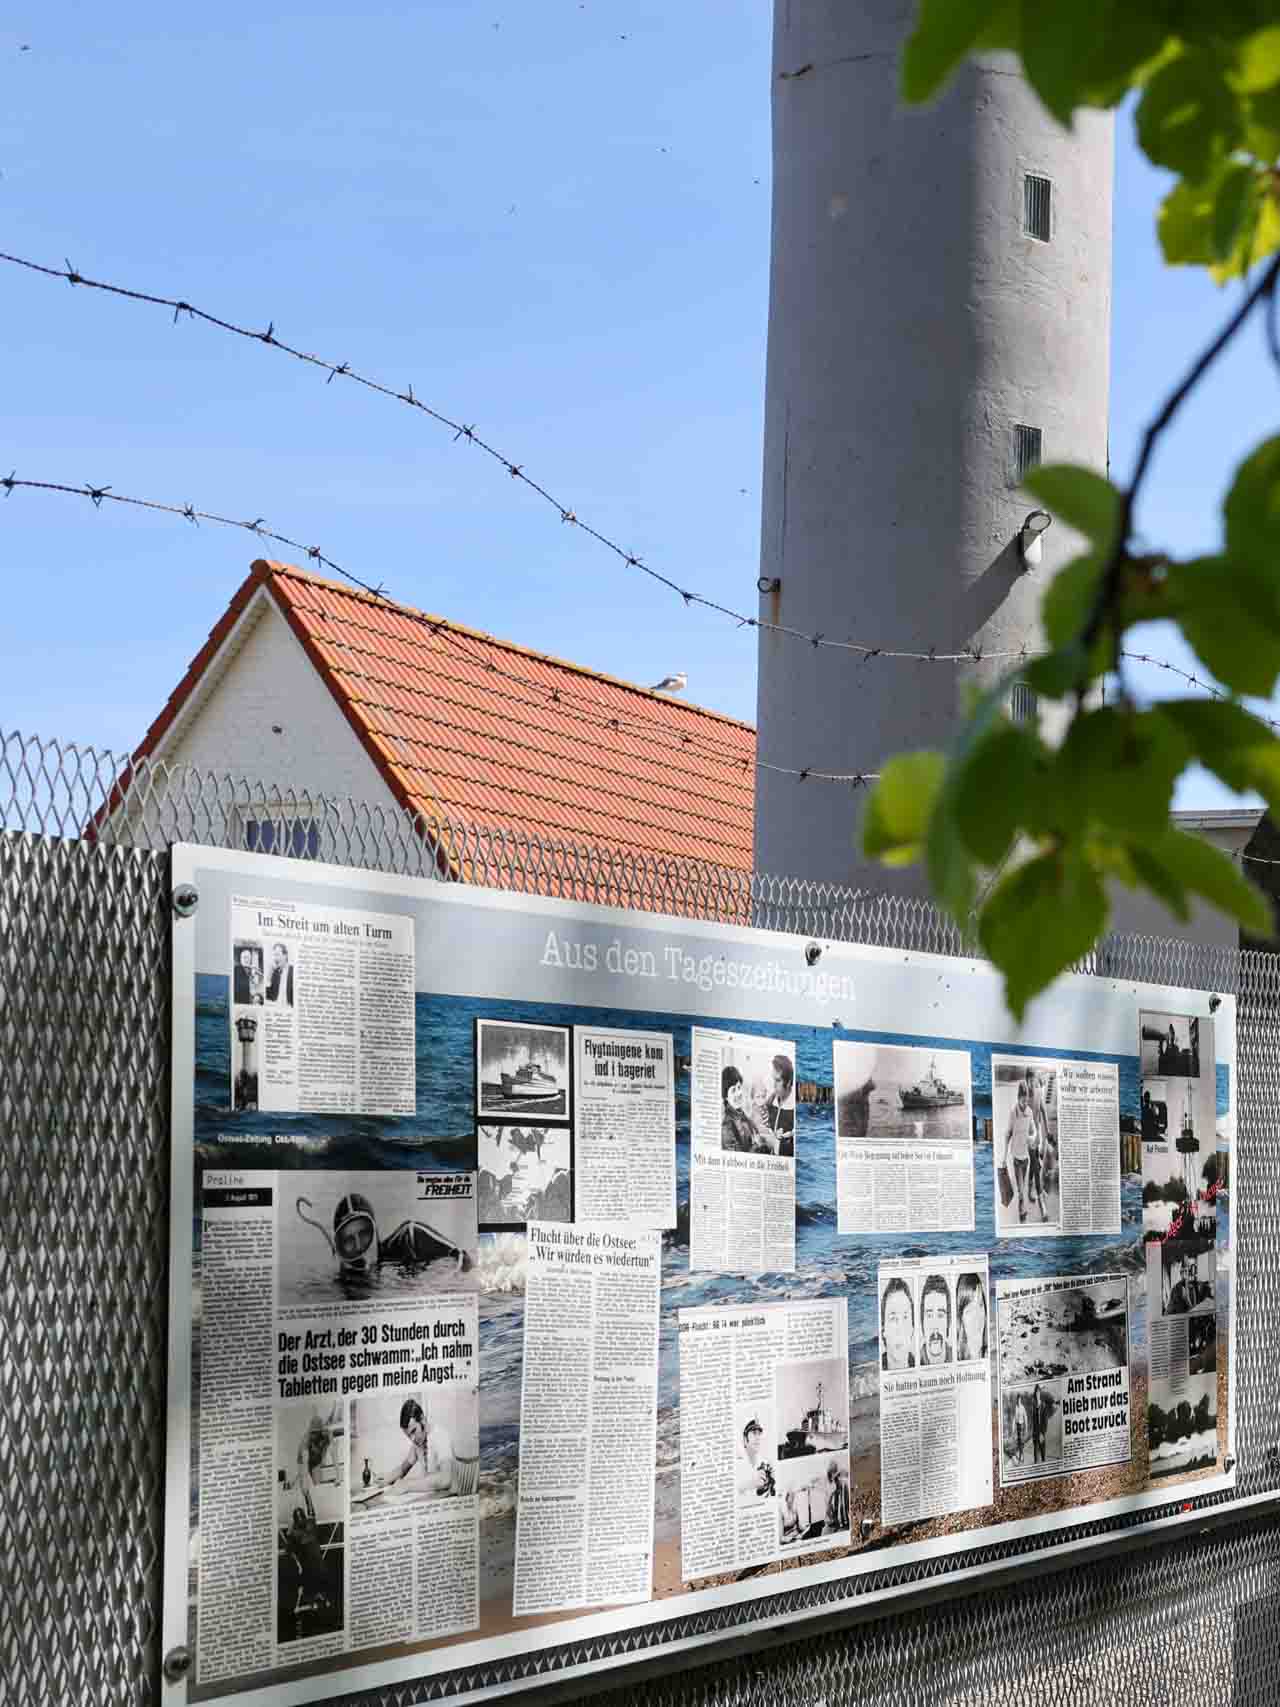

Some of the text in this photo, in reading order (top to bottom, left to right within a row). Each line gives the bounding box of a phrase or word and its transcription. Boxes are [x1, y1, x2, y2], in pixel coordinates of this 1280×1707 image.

[257, 912, 273, 927] Im
[278, 914, 308, 931] Streit
[313, 921, 329, 933] um
[333, 922, 360, 937] alten
[364, 923, 392, 940] Turm
[539, 930, 856, 1003] Aus den Tageszeitungen
[645, 1044, 664, 1060] kom
[425, 1183, 472, 1195] FREIHEIT
[530, 1227, 636, 1249] Flucht über die Ostsee:
[558, 1250, 591, 1265] würden
[594, 1253, 603, 1264] es
[278, 1332, 301, 1352] Der
[337, 1327, 358, 1346] der
[361, 1325, 377, 1344] 30
[381, 1322, 430, 1342] Stunden
[433, 1319, 465, 1338] durch
[278, 1354, 298, 1374] die
[302, 1352, 346, 1372] Ostsee
[442, 1339, 472, 1359] nahm
[278, 1376, 337, 1398] Tabletten
[342, 1373, 378, 1394] gegen
[382, 1366, 418, 1387] meine
[1067, 1369, 1122, 1394] Am Strand
[1062, 1391, 1129, 1416] blieb nur das
[1064, 1410, 1127, 1435] Boot zurück
